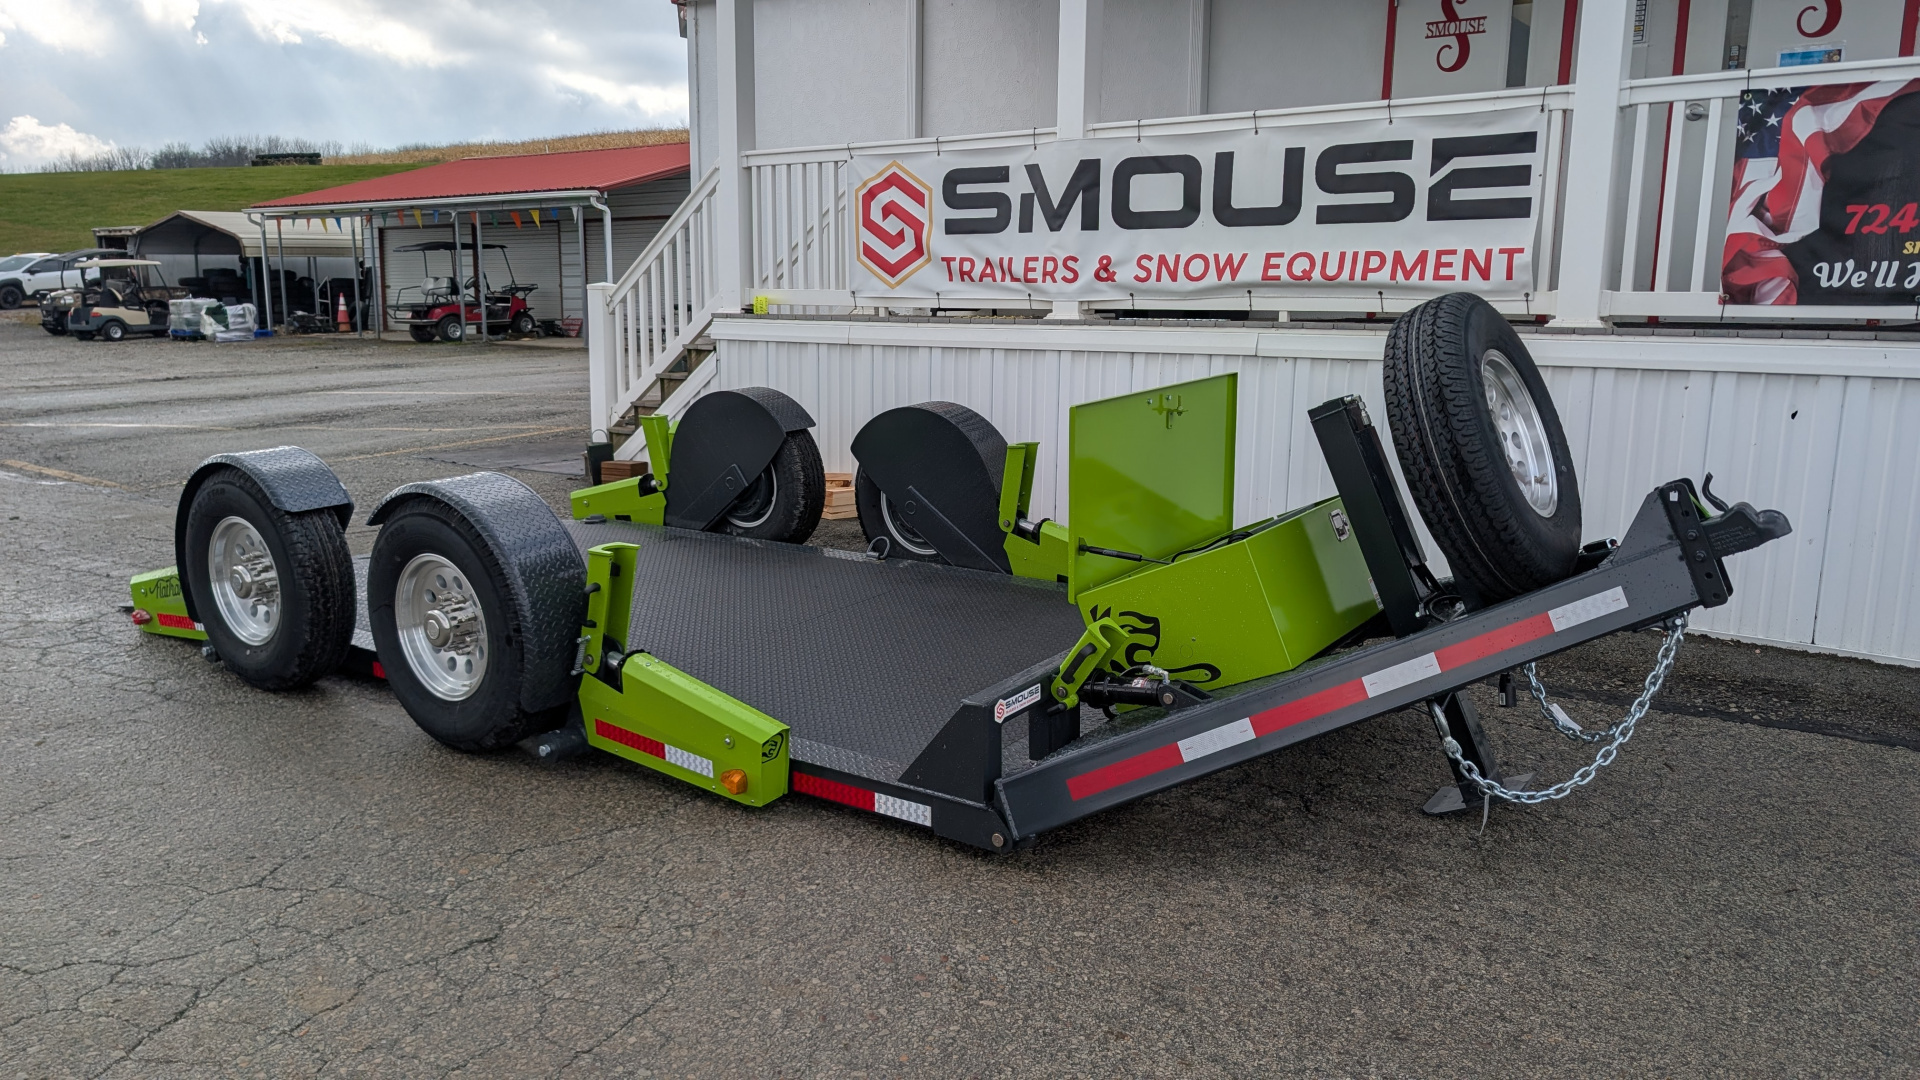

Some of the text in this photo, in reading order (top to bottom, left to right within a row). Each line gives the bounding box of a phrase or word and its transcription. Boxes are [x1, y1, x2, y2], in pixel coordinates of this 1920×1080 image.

[1426, 19, 1486, 37] SMOUSE
[943, 131, 1538, 237] SMOUSE
[1844, 202, 1920, 235] 724
[941, 247, 1525, 284] TRAILERS & SNOW EQUIPMENT
[1812, 258, 1900, 288] We'll
[1005, 686, 1040, 709] SMOUSE
